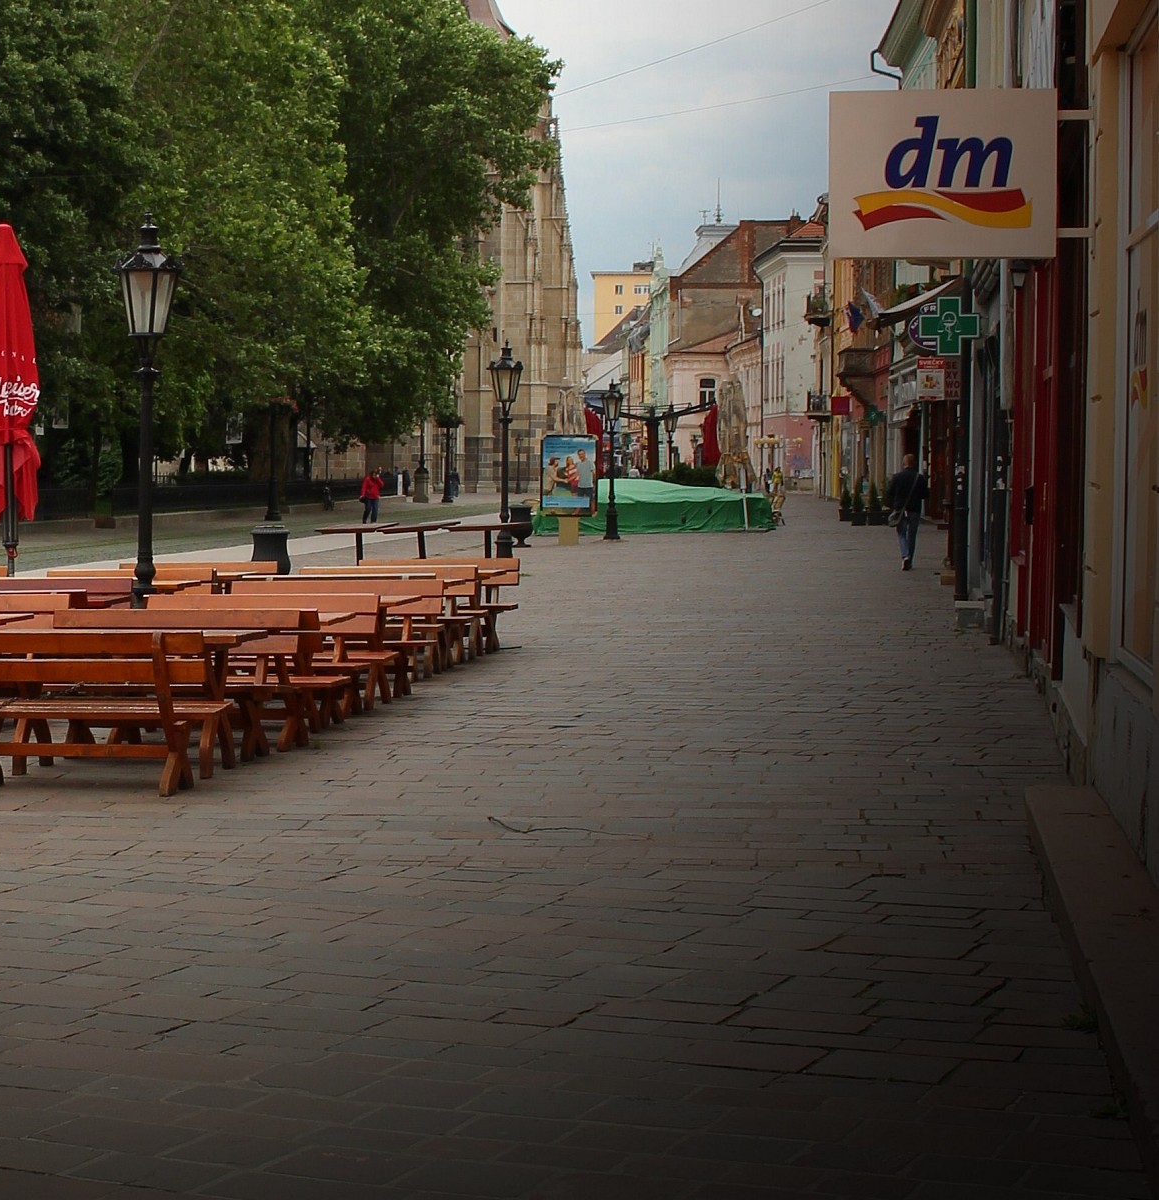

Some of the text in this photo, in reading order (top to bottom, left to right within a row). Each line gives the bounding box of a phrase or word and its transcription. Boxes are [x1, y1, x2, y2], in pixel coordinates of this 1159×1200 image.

[884, 115, 1013, 189] dm
[946, 371, 959, 379] XY
[946, 381, 960, 389] WO
